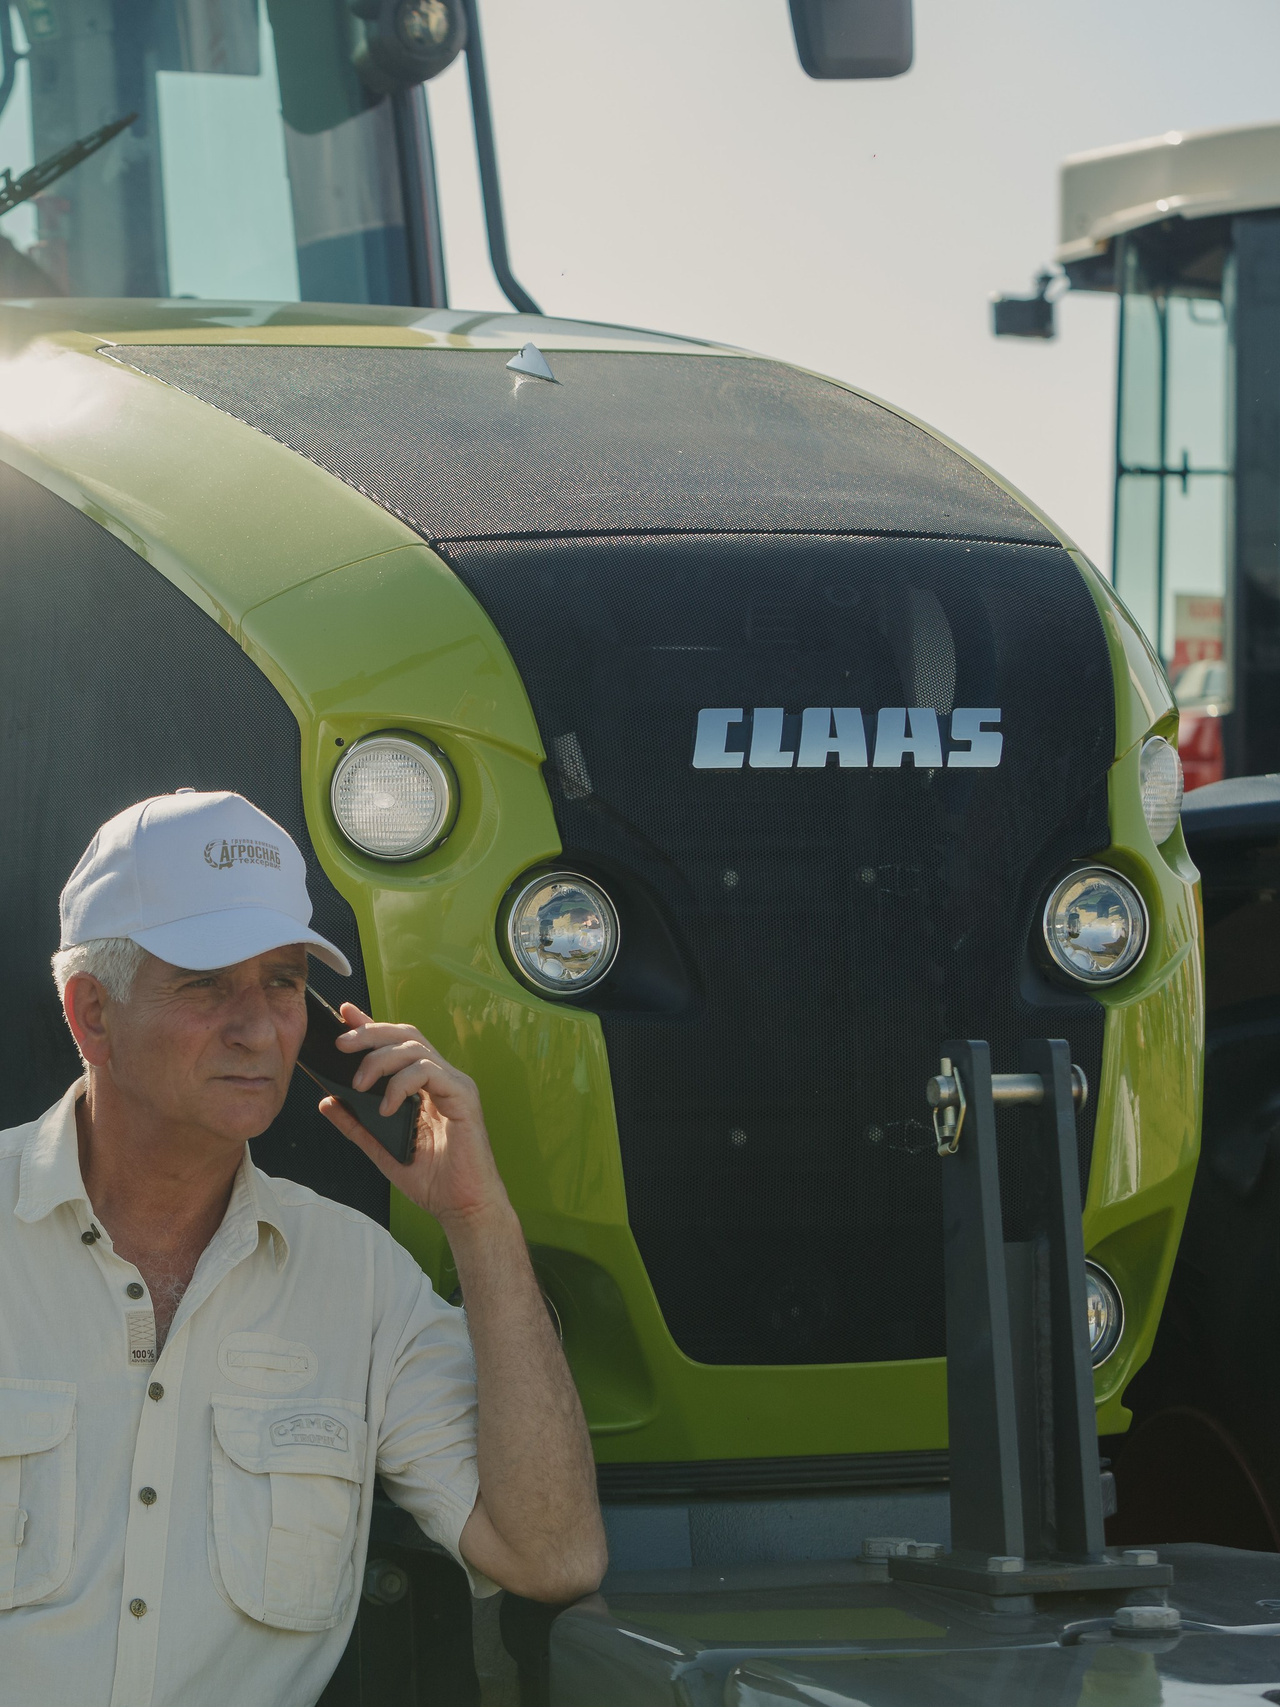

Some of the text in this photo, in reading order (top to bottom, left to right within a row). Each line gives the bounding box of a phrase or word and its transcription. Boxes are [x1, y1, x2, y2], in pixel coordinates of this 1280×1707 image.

[692, 707, 1004, 768] CLAAS
[220, 842, 281, 865] АГРОСНАБ
[132, 1350, 155, 1359] 100%
[274, 1417, 344, 1441] CAMEL
[291, 1434, 336, 1447] TROPHY
